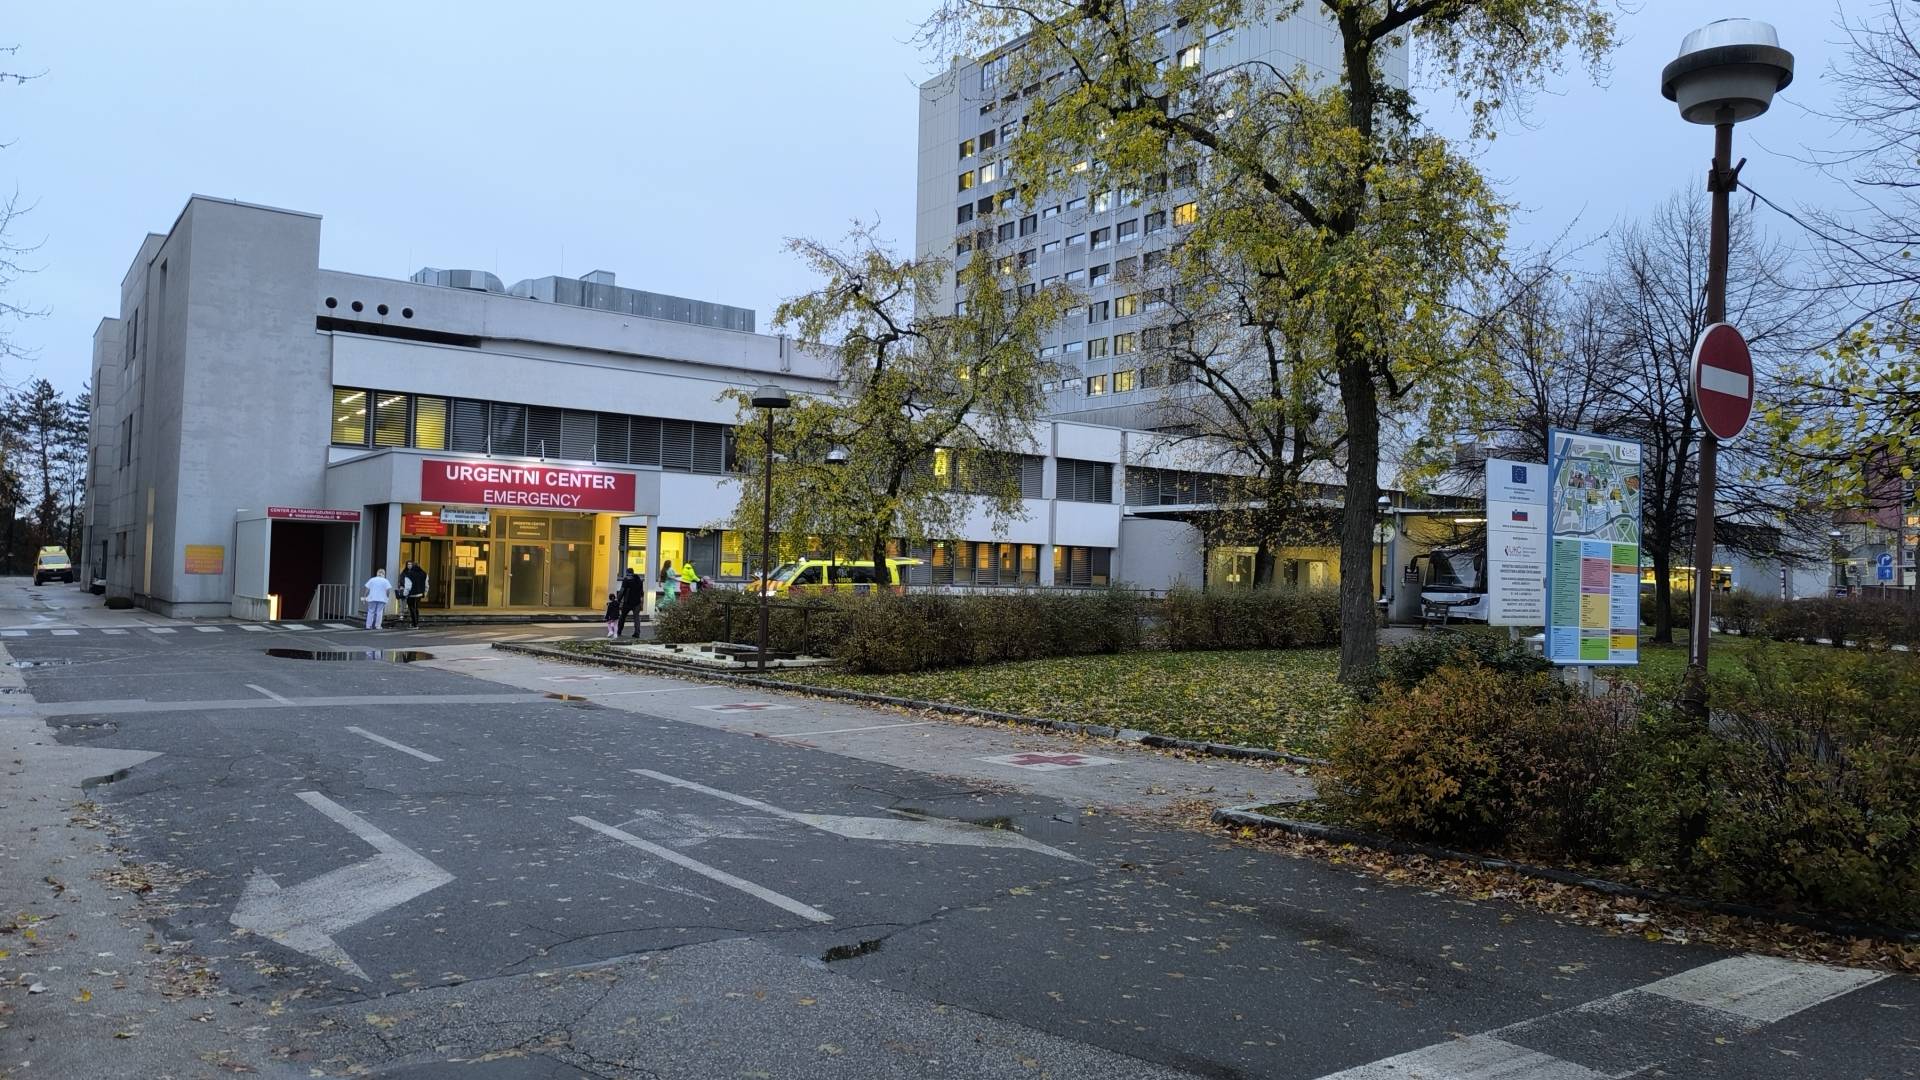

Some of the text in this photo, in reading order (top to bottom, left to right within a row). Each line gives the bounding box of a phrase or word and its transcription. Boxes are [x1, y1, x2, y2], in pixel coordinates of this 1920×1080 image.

[446, 465, 616, 489] URGENTNI CENTER
[483, 489, 581, 507] EMERGENCY
